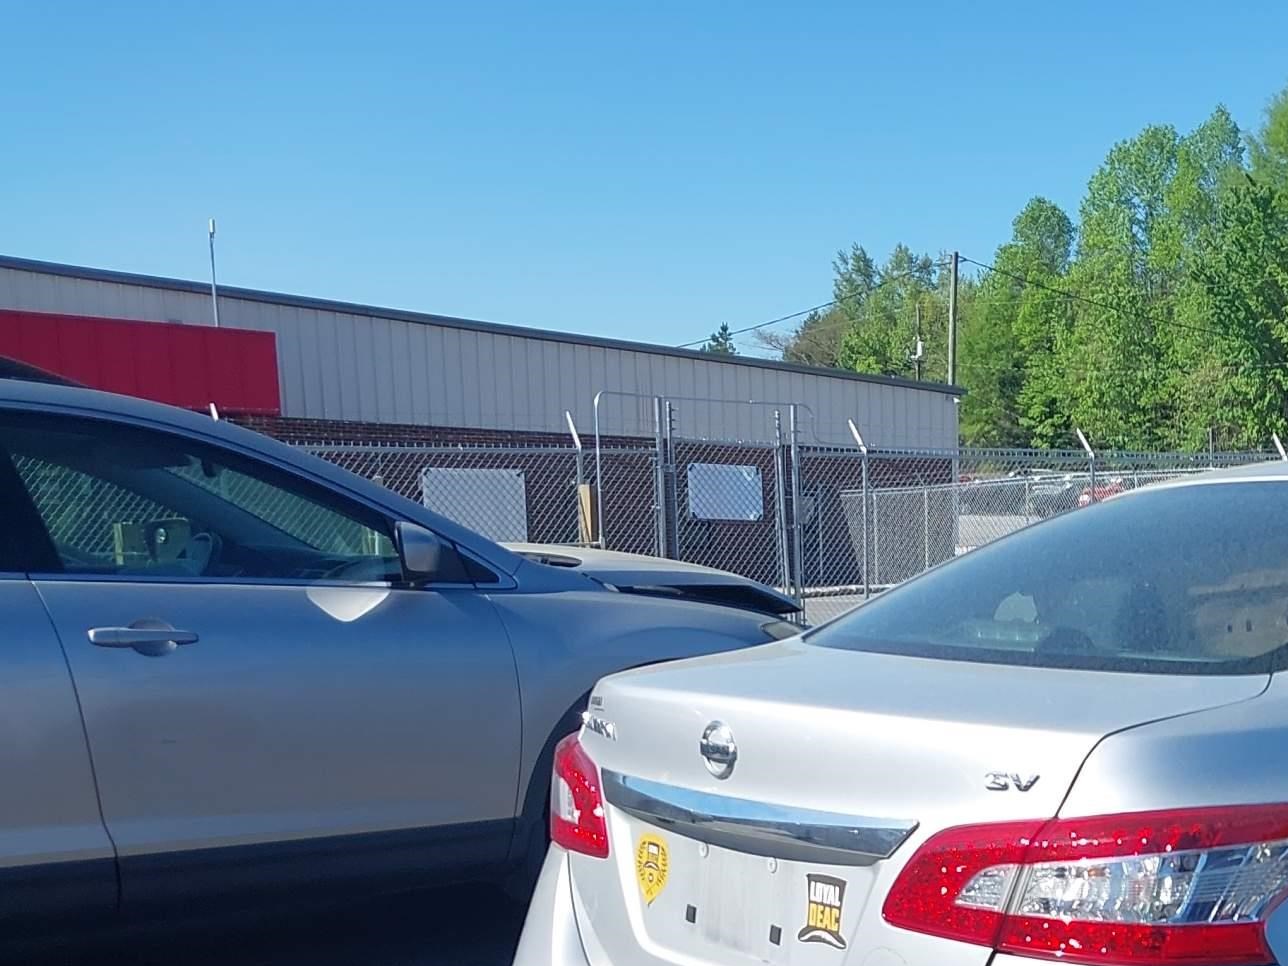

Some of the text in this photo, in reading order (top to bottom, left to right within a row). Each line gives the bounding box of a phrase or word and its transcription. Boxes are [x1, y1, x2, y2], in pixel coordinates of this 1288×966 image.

[985, 772, 1040, 792] SV
[810, 881, 841, 907] LOYAL
[808, 903, 840, 932] DEAC
